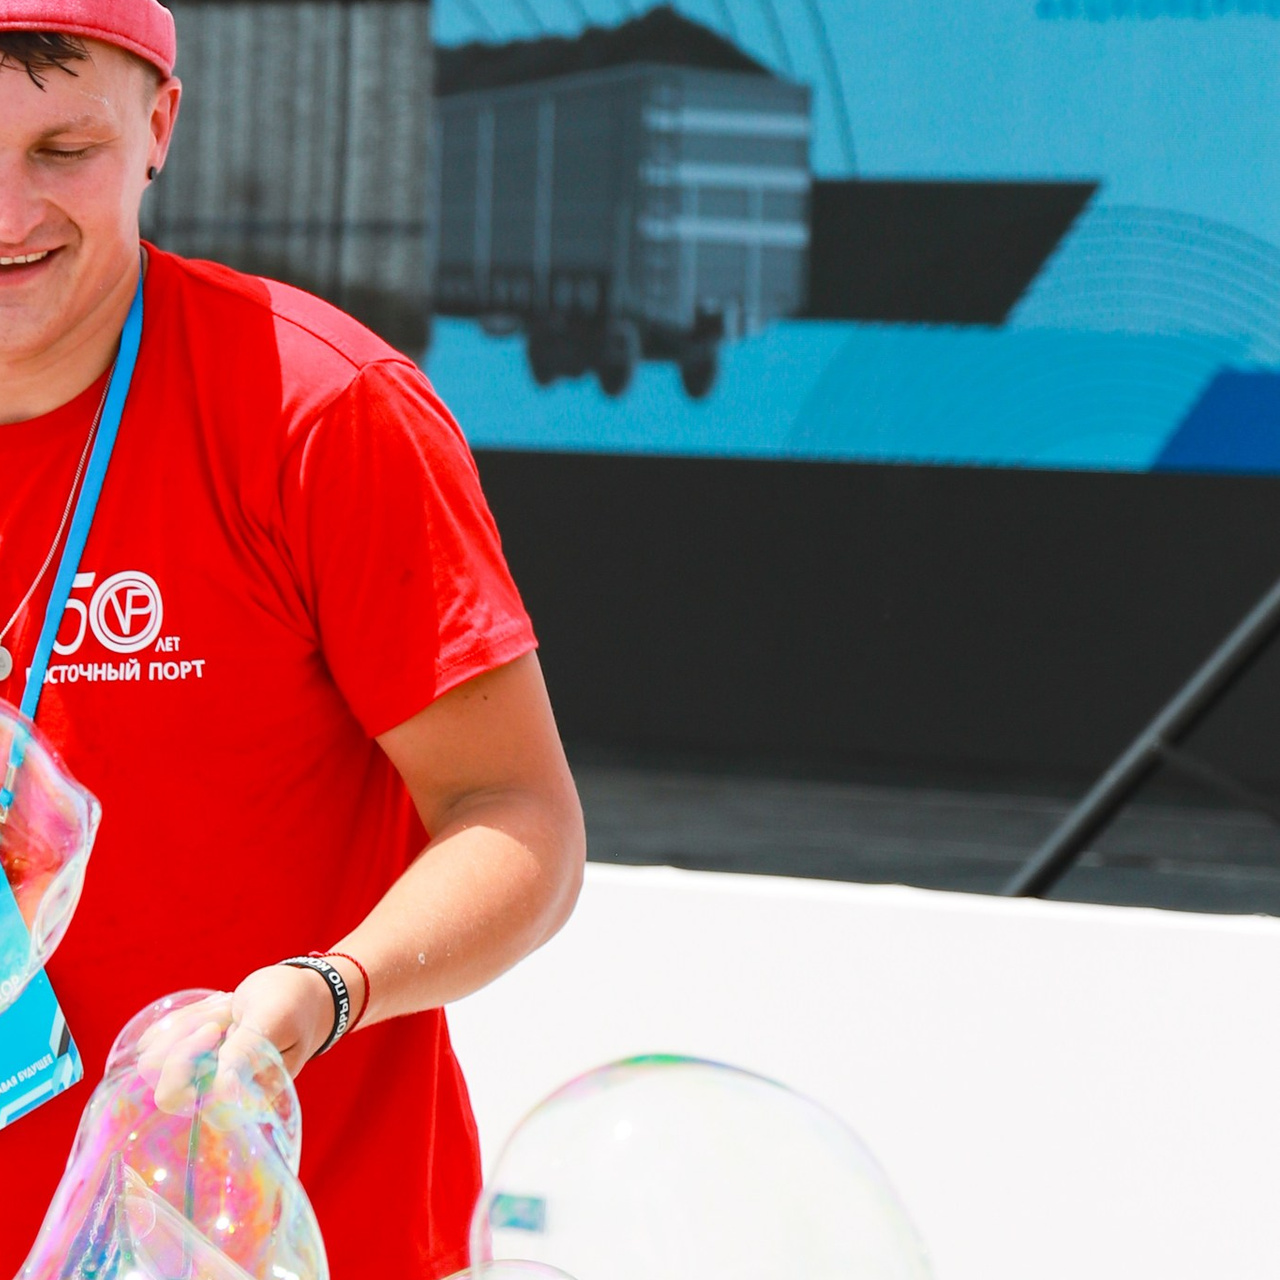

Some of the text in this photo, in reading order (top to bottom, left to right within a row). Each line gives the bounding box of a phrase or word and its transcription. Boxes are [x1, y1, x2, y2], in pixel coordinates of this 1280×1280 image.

[155, 636, 180, 652] ЛЕТ
[149, 660, 205, 681] ПОРТ
[328, 971, 347, 996] ПО
